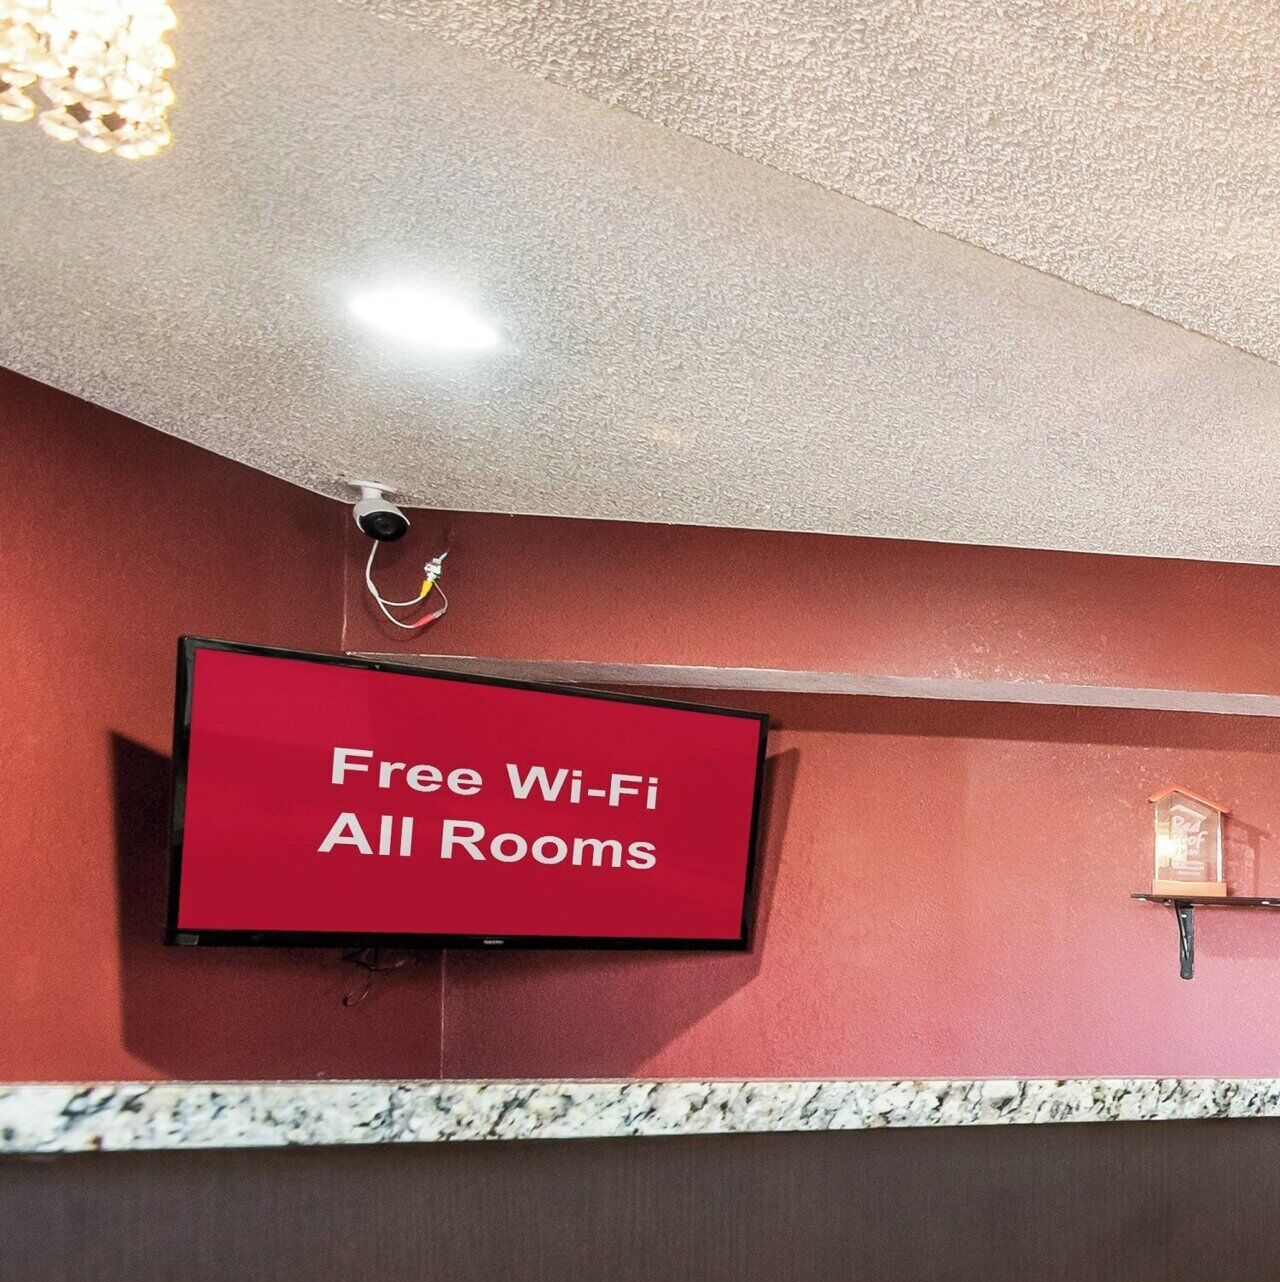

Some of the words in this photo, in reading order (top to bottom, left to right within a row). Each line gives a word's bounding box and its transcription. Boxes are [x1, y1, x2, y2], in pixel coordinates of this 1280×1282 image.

[331, 746, 484, 797] Free
[506, 763, 659, 811] Wi-Fi
[317, 811, 414, 858] All
[440, 819, 657, 870] Rooms
